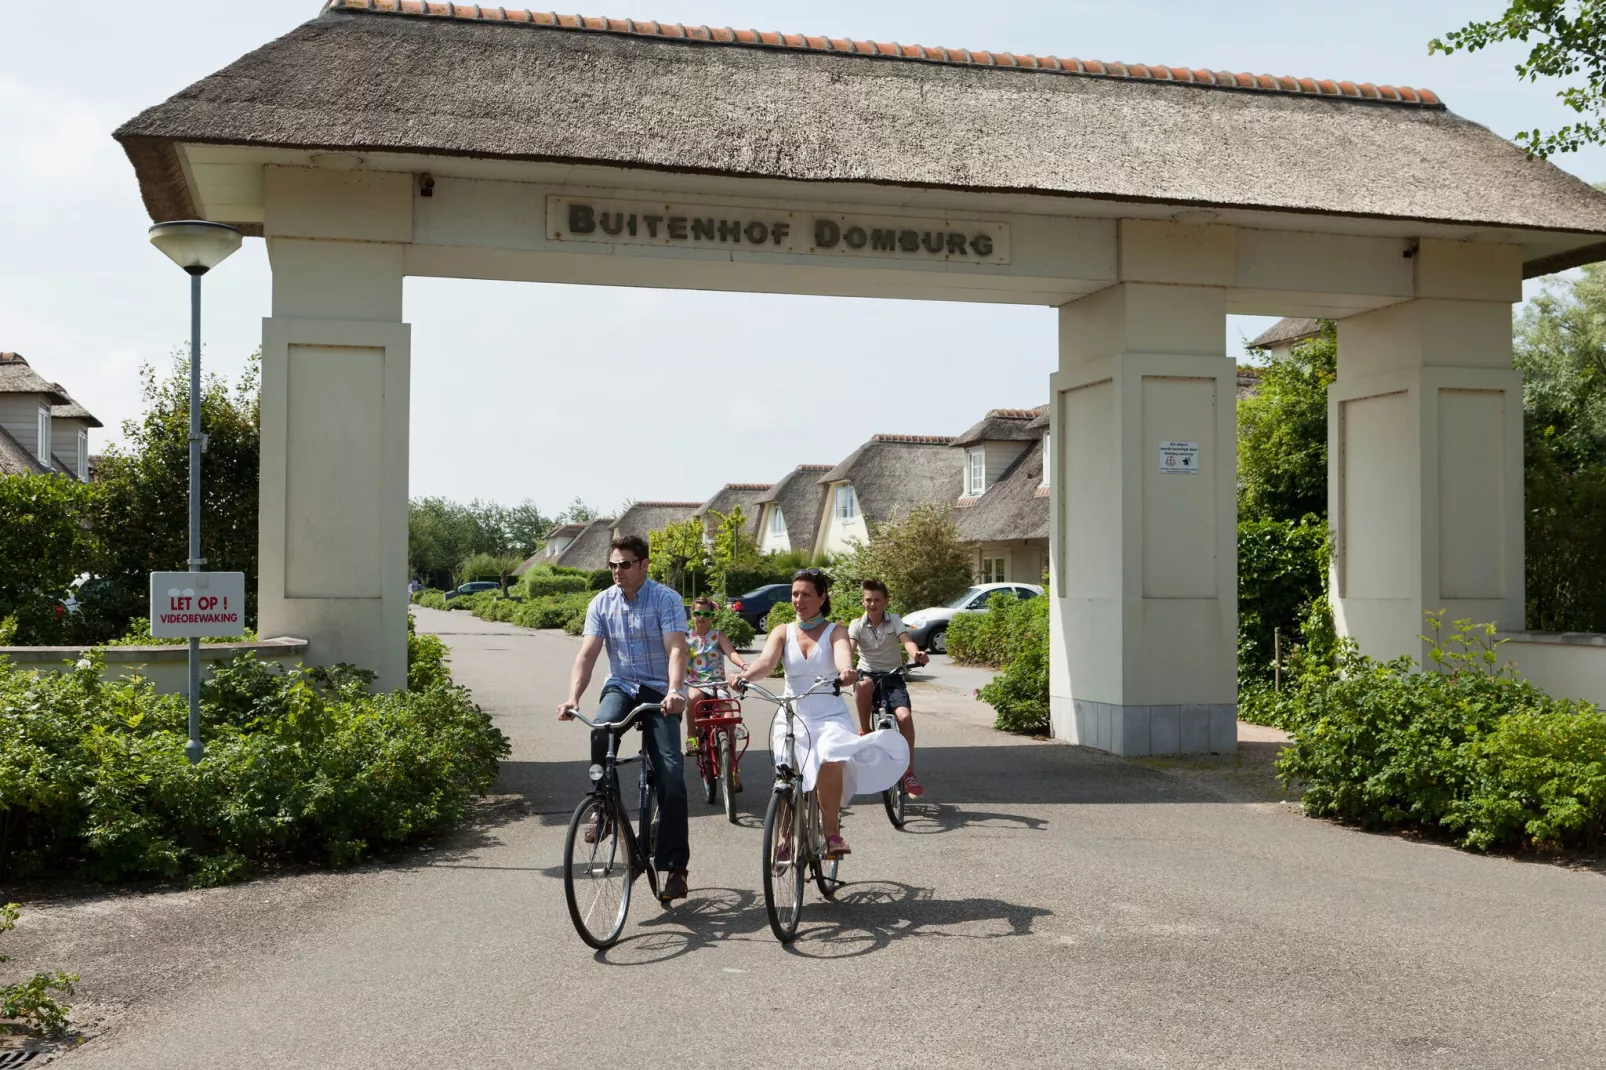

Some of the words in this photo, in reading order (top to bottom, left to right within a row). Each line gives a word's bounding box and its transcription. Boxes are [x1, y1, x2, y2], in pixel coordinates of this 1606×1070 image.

[569, 204, 790, 245] BUITENHOF
[814, 219, 993, 256] DOMBURG
[170, 597, 192, 610] LET
[198, 597, 218, 610] OP
[160, 613, 238, 623] VIDEOBEWAKING
